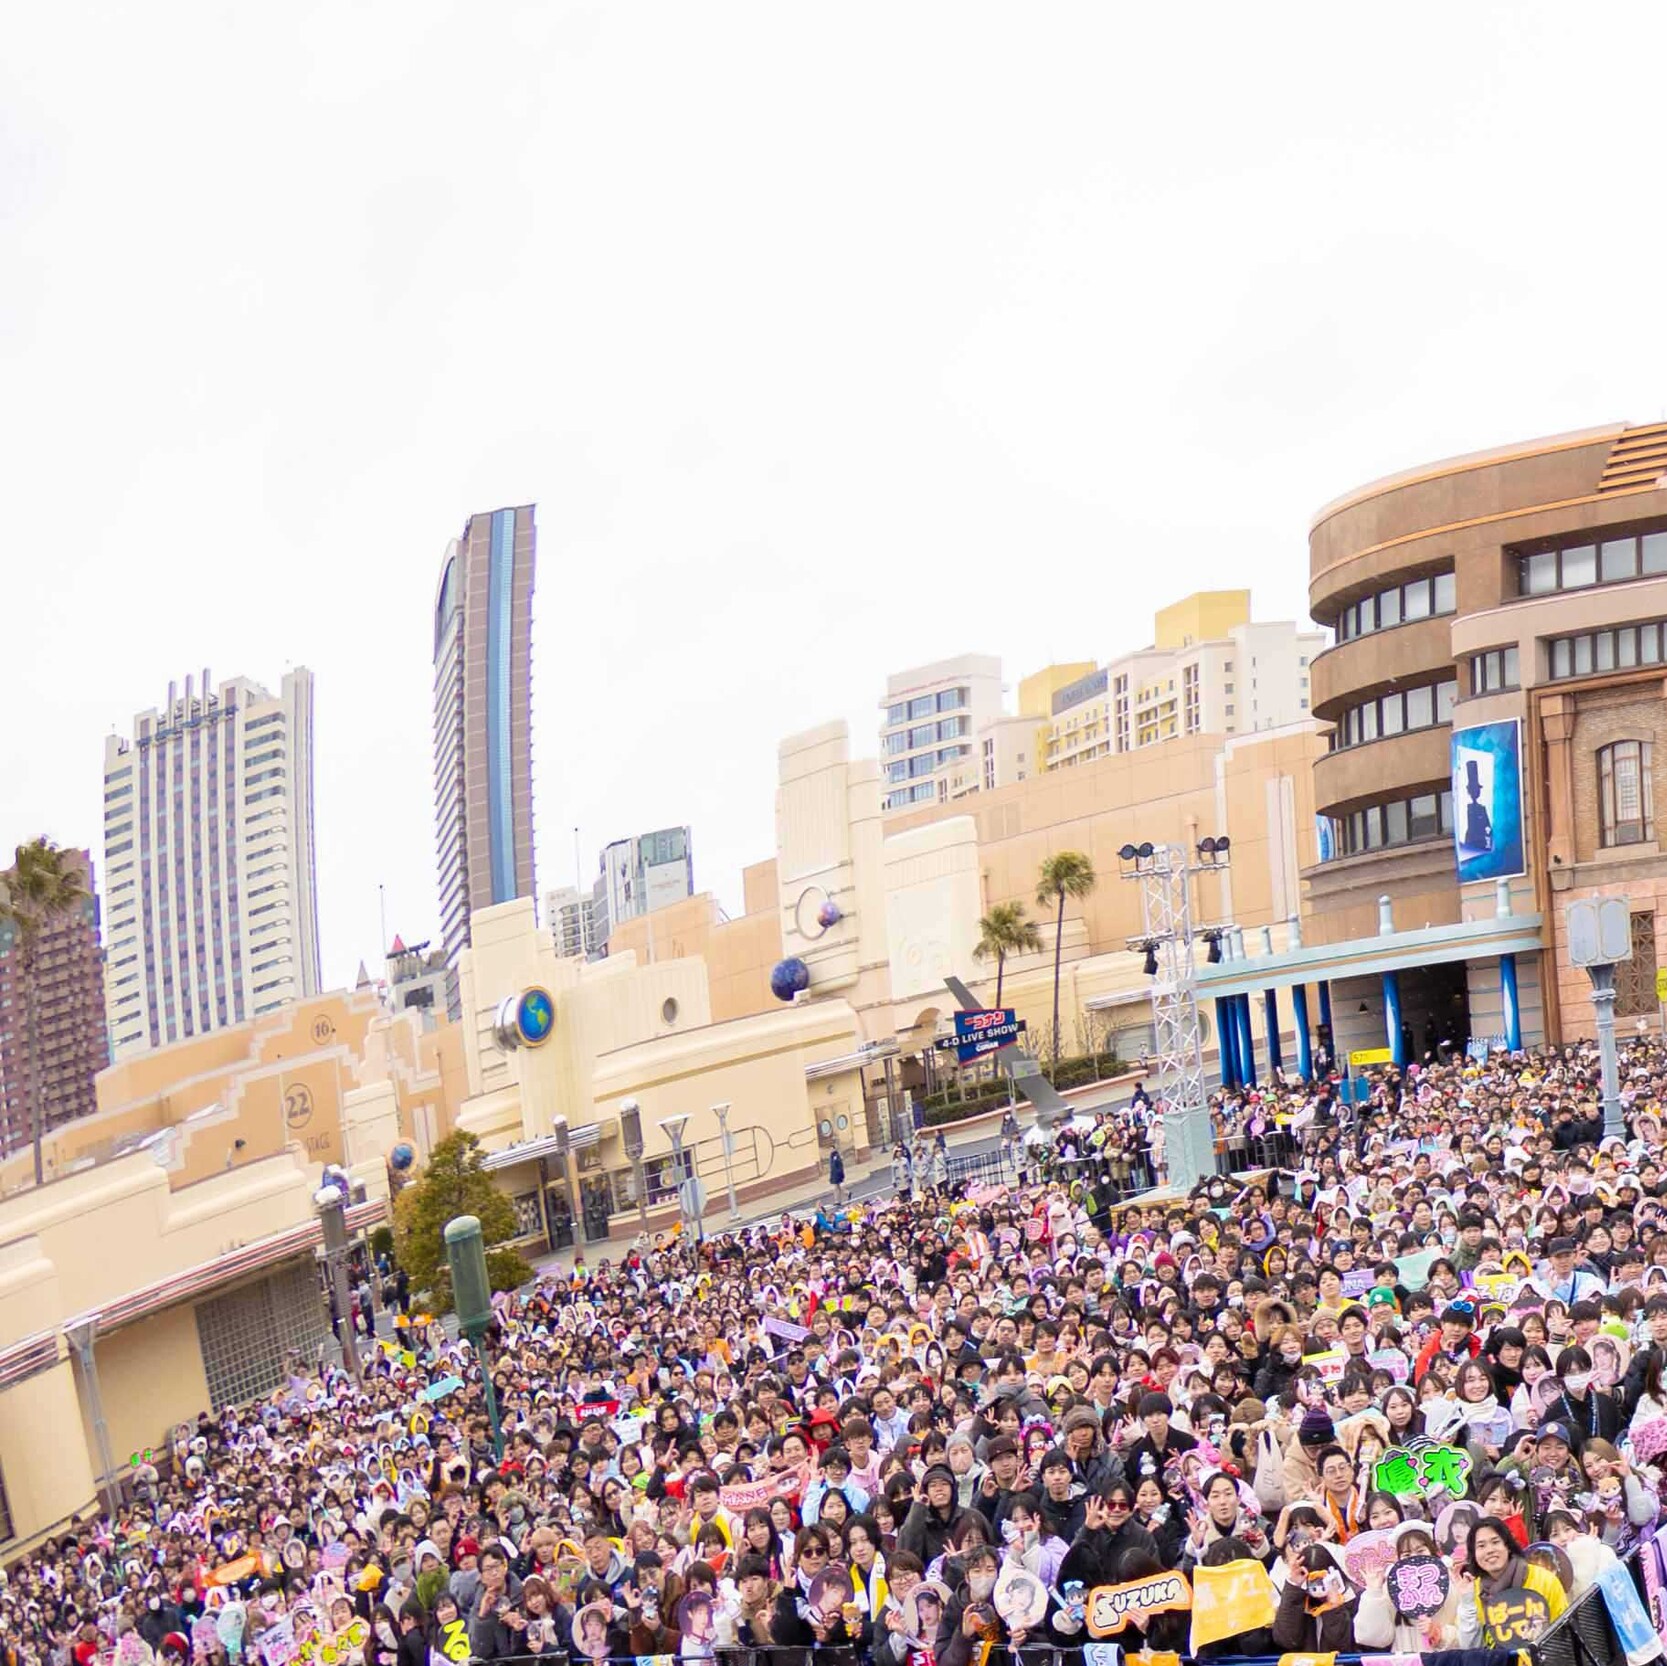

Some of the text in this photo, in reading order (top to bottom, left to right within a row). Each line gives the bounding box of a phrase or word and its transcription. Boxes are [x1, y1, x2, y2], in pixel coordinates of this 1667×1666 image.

[962, 1030, 985, 1044] LIVE
[987, 1023, 1019, 1038] SHOW
[286, 1091, 310, 1119] 22
[1396, 1564, 1441, 1588] まつ
[1093, 1578, 1188, 1629] SUZUKA
[1398, 1586, 1444, 1611] かれ
[443, 1619, 472, 1661] る
